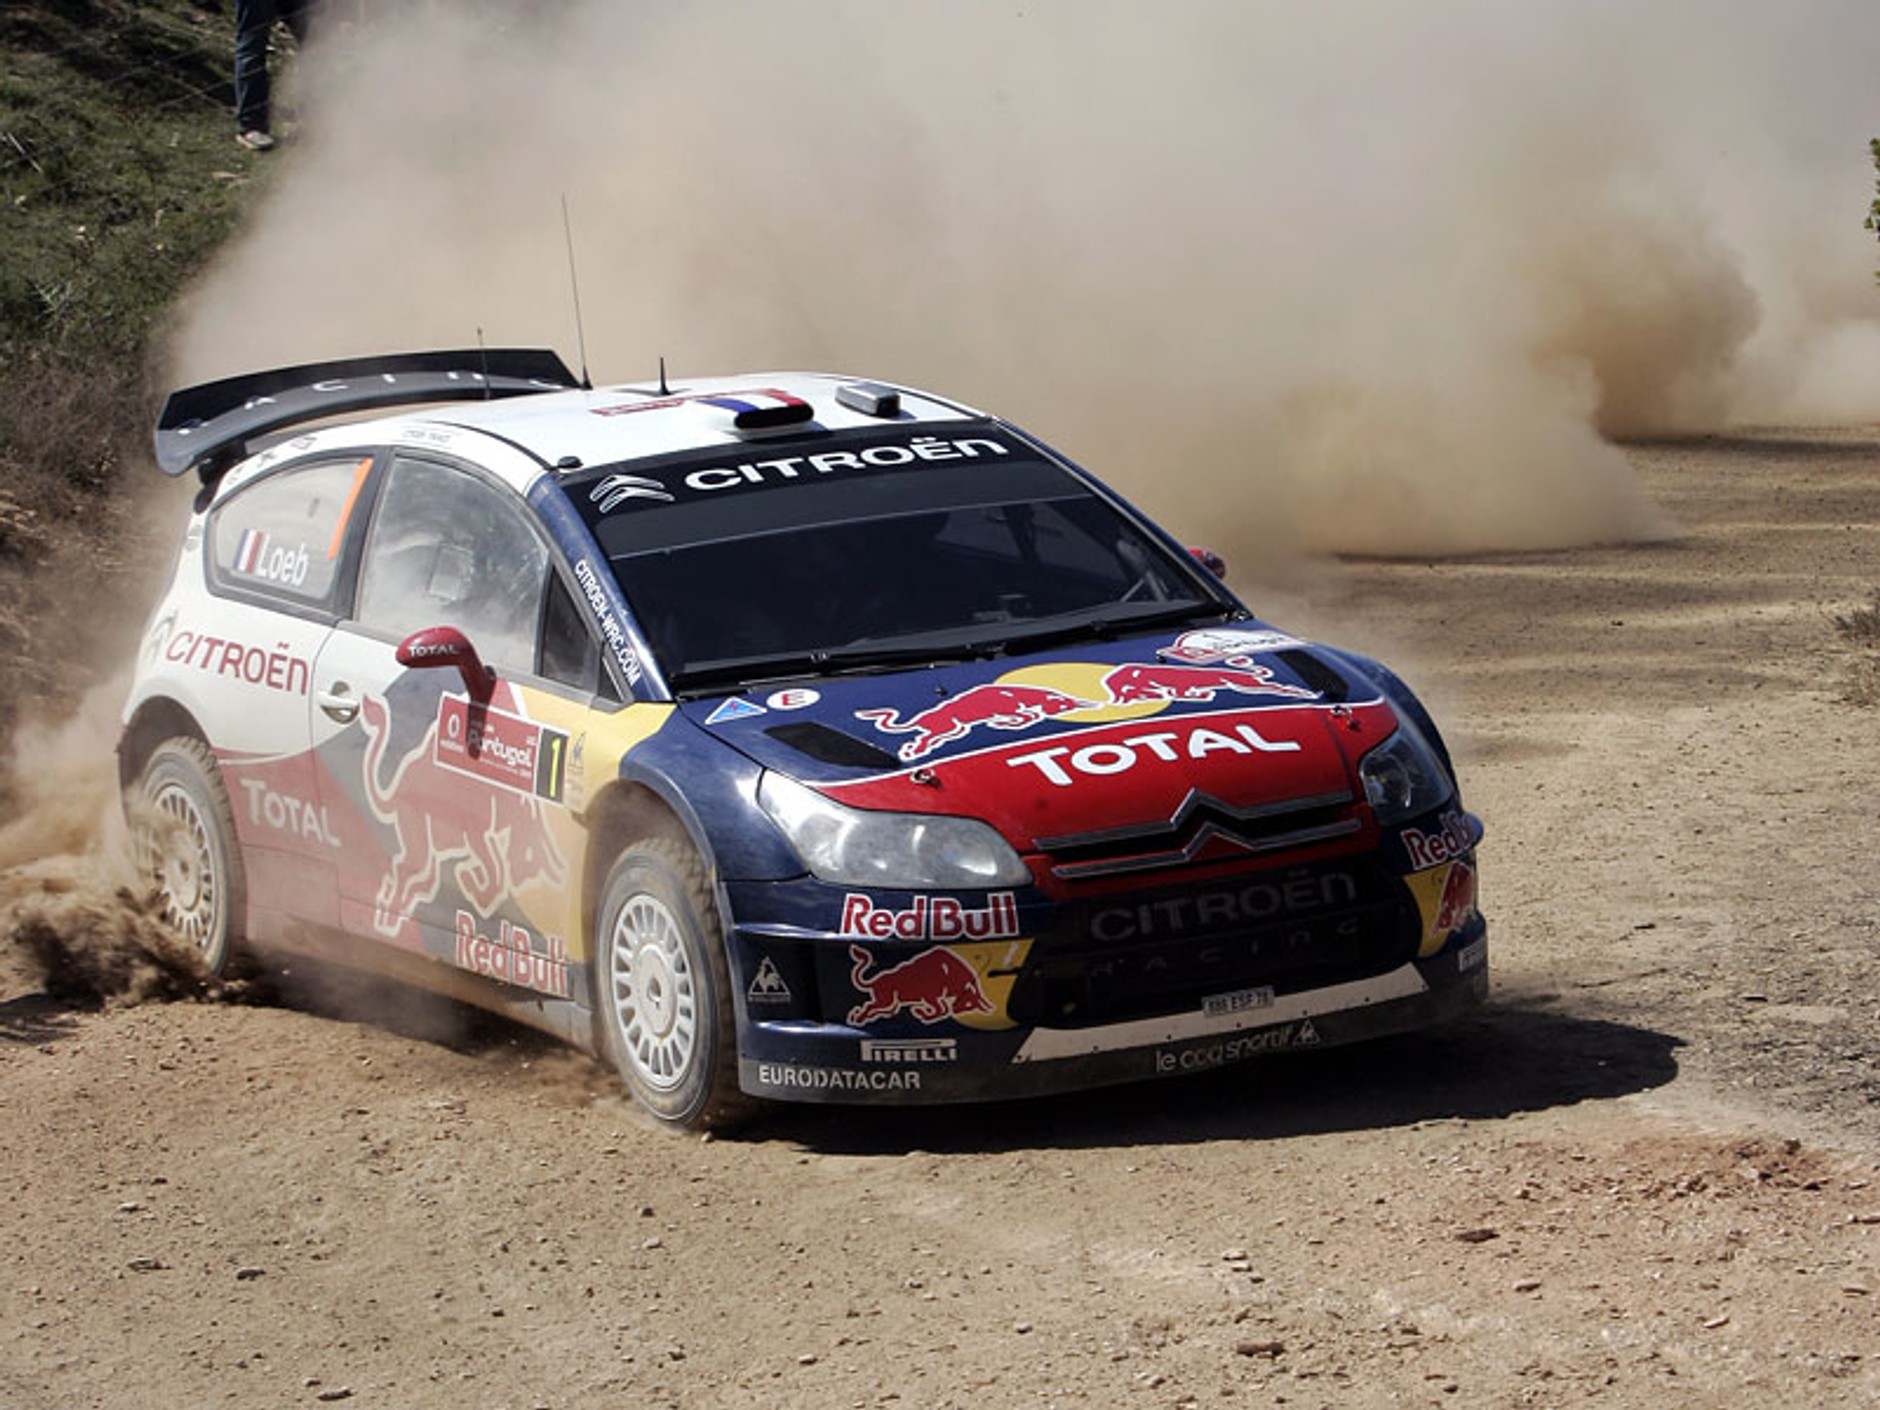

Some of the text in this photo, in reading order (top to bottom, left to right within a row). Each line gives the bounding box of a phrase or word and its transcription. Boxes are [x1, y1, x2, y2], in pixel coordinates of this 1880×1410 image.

[255, 533, 309, 586] Loeb
[407, 644, 460, 658] TOTAL
[548, 737, 561, 798] 1
[1006, 724, 1301, 786] TOTAL
[239, 777, 342, 848] TOTAL
[840, 890, 1019, 941] Red Bull
[456, 910, 568, 998] Red Bull
[861, 1039, 957, 1062] PIRELLI
[1155, 1049, 1177, 1072] le
[758, 1064, 921, 1090] EURODATACAR
